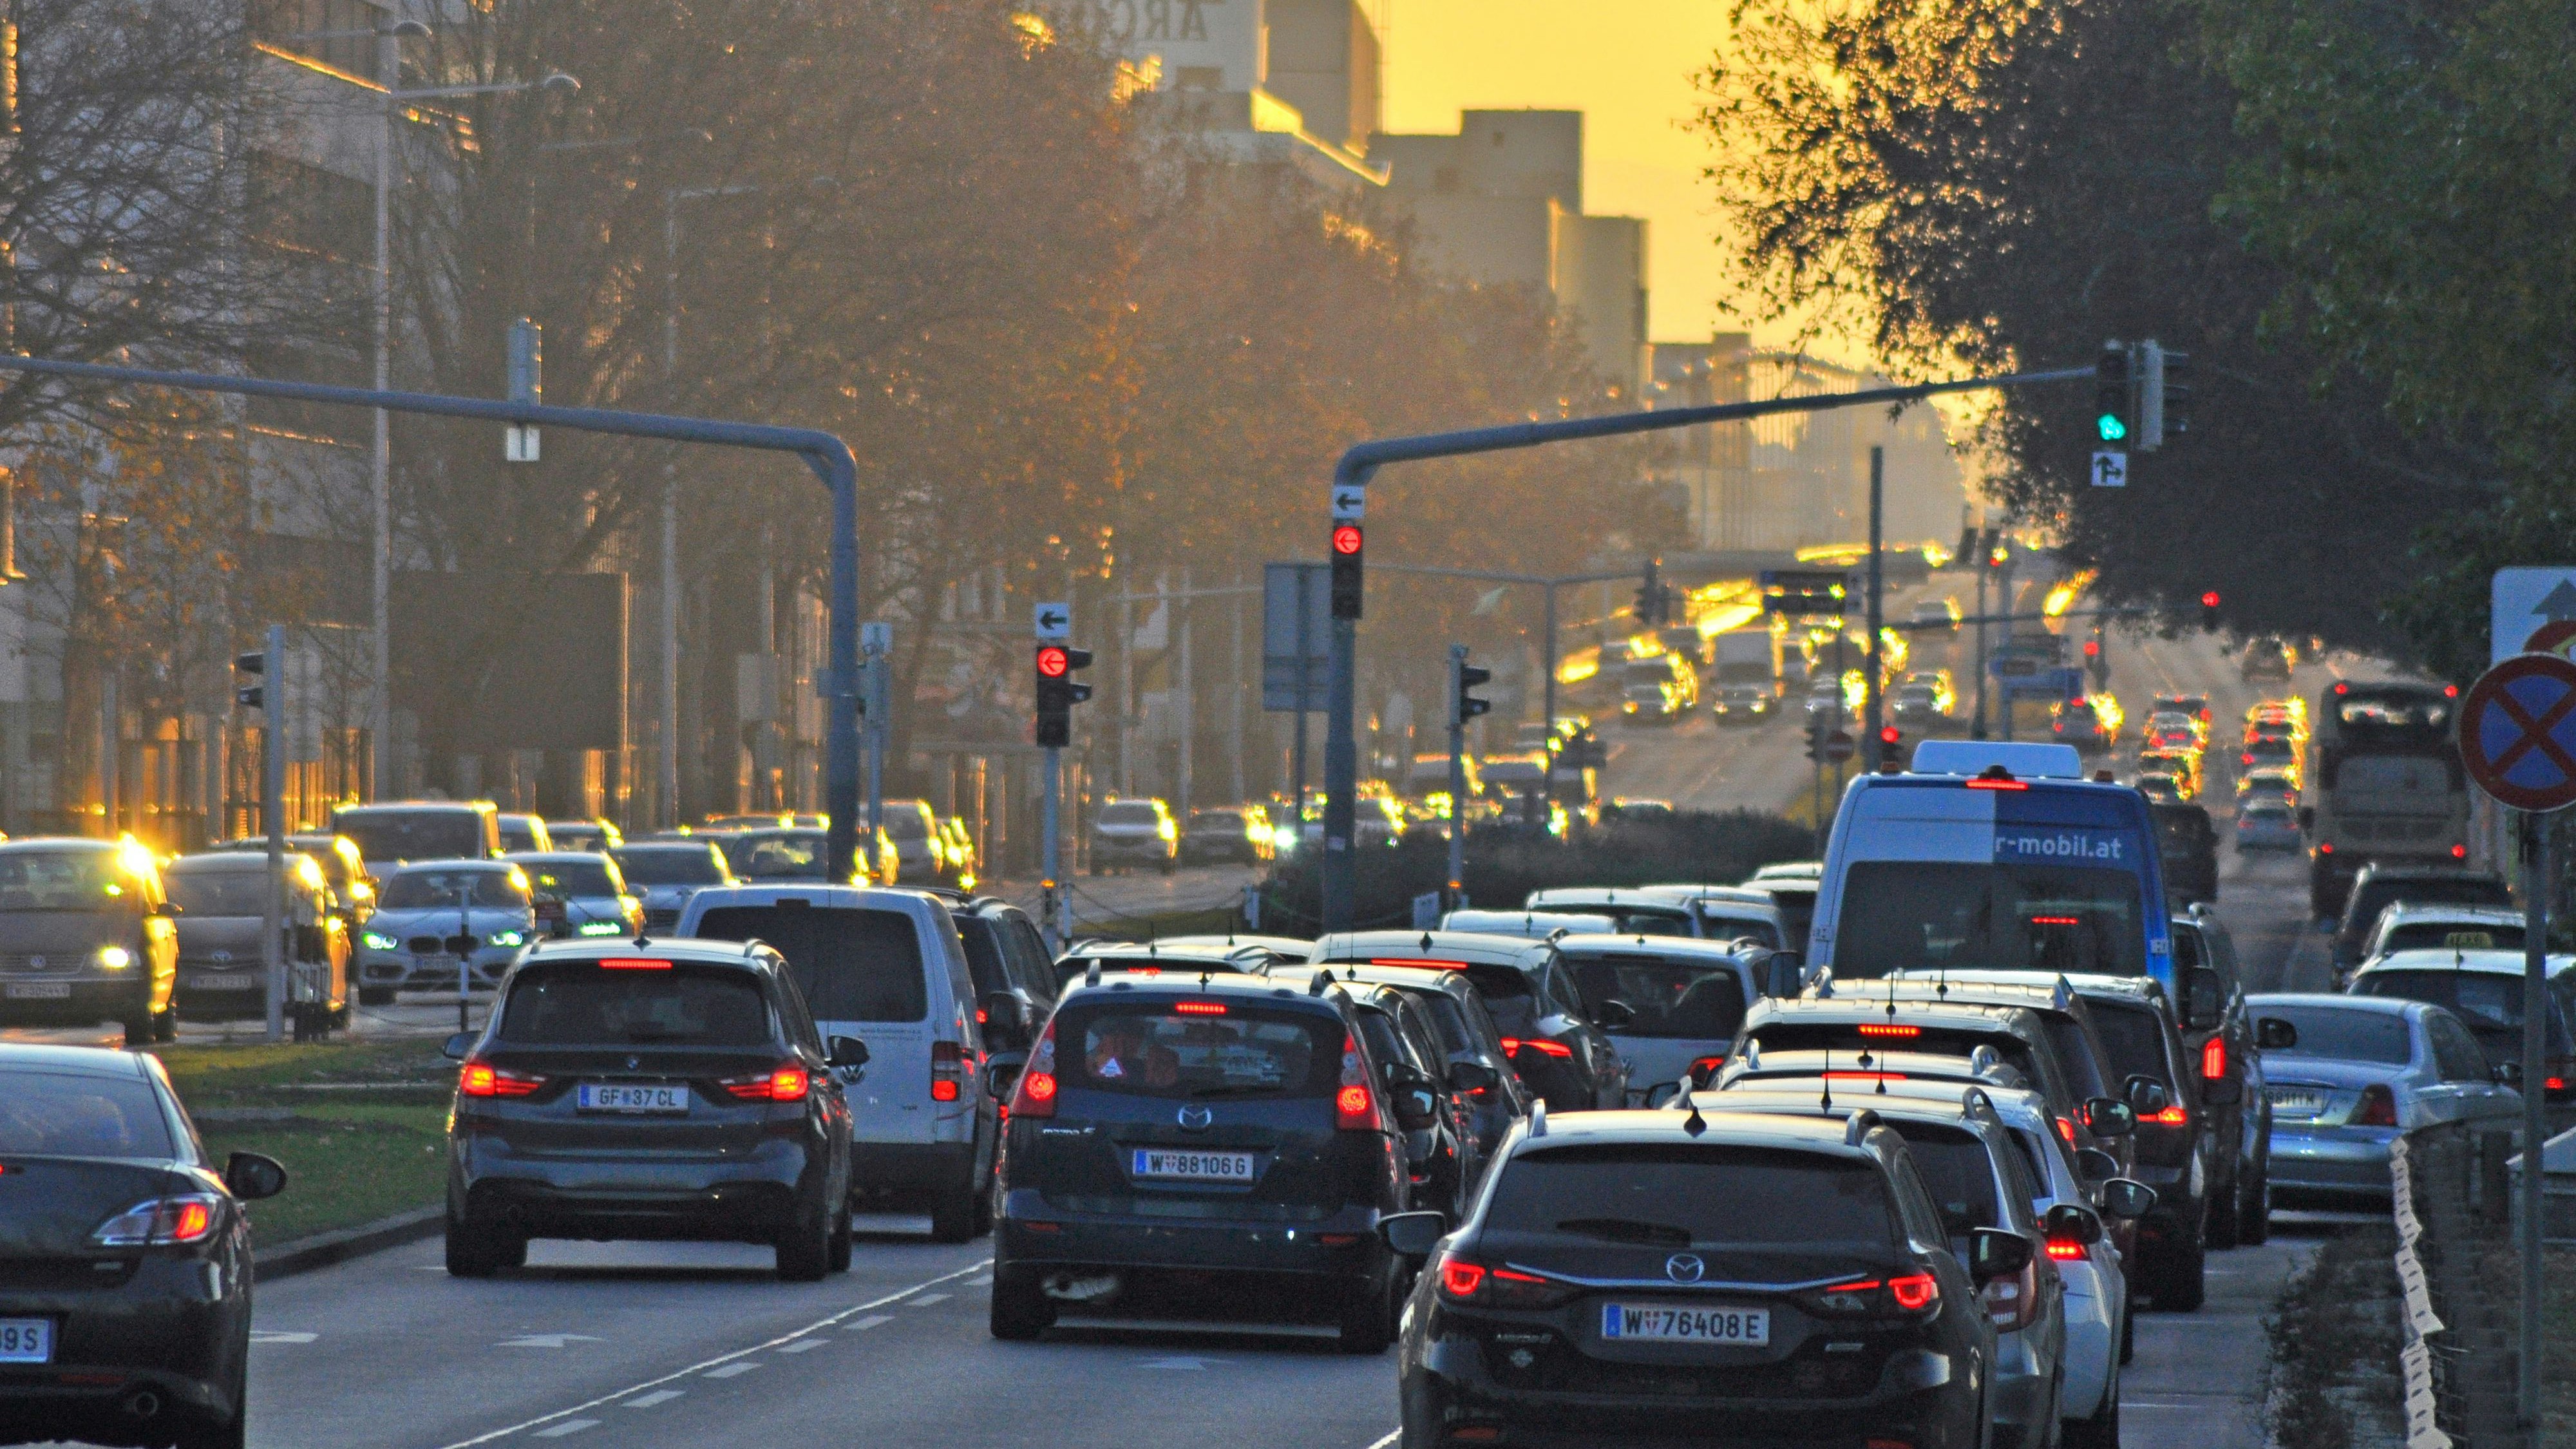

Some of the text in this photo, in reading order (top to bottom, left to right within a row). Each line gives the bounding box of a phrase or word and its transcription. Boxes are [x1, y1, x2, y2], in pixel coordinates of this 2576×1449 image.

[1996, 835, 2121, 858] r-mobil.at
[600, 1088, 677, 1106] GF 37 CL
[1150, 1155, 1246, 1175] W 88106 G
[1625, 1309, 1760, 1339] W 76408 E
[0, 1327, 18, 1351] 9
